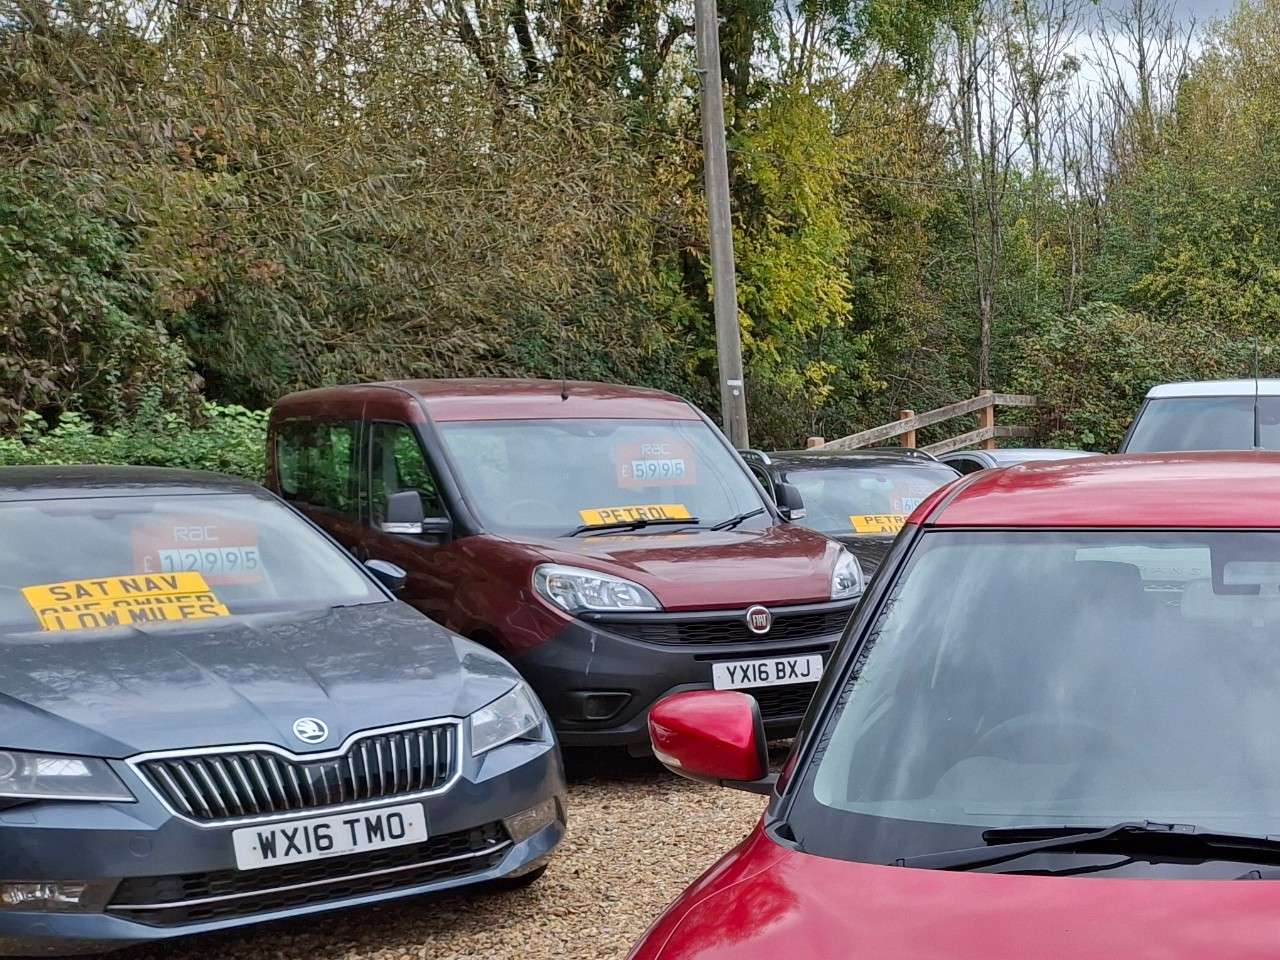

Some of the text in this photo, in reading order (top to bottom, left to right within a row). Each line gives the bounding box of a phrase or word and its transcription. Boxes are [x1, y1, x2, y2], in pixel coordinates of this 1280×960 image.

[49, 574, 179, 601] SAT NAV
[726, 658, 811, 685] YX16 BXJ
[257, 812, 405, 859] WX16 TMO
